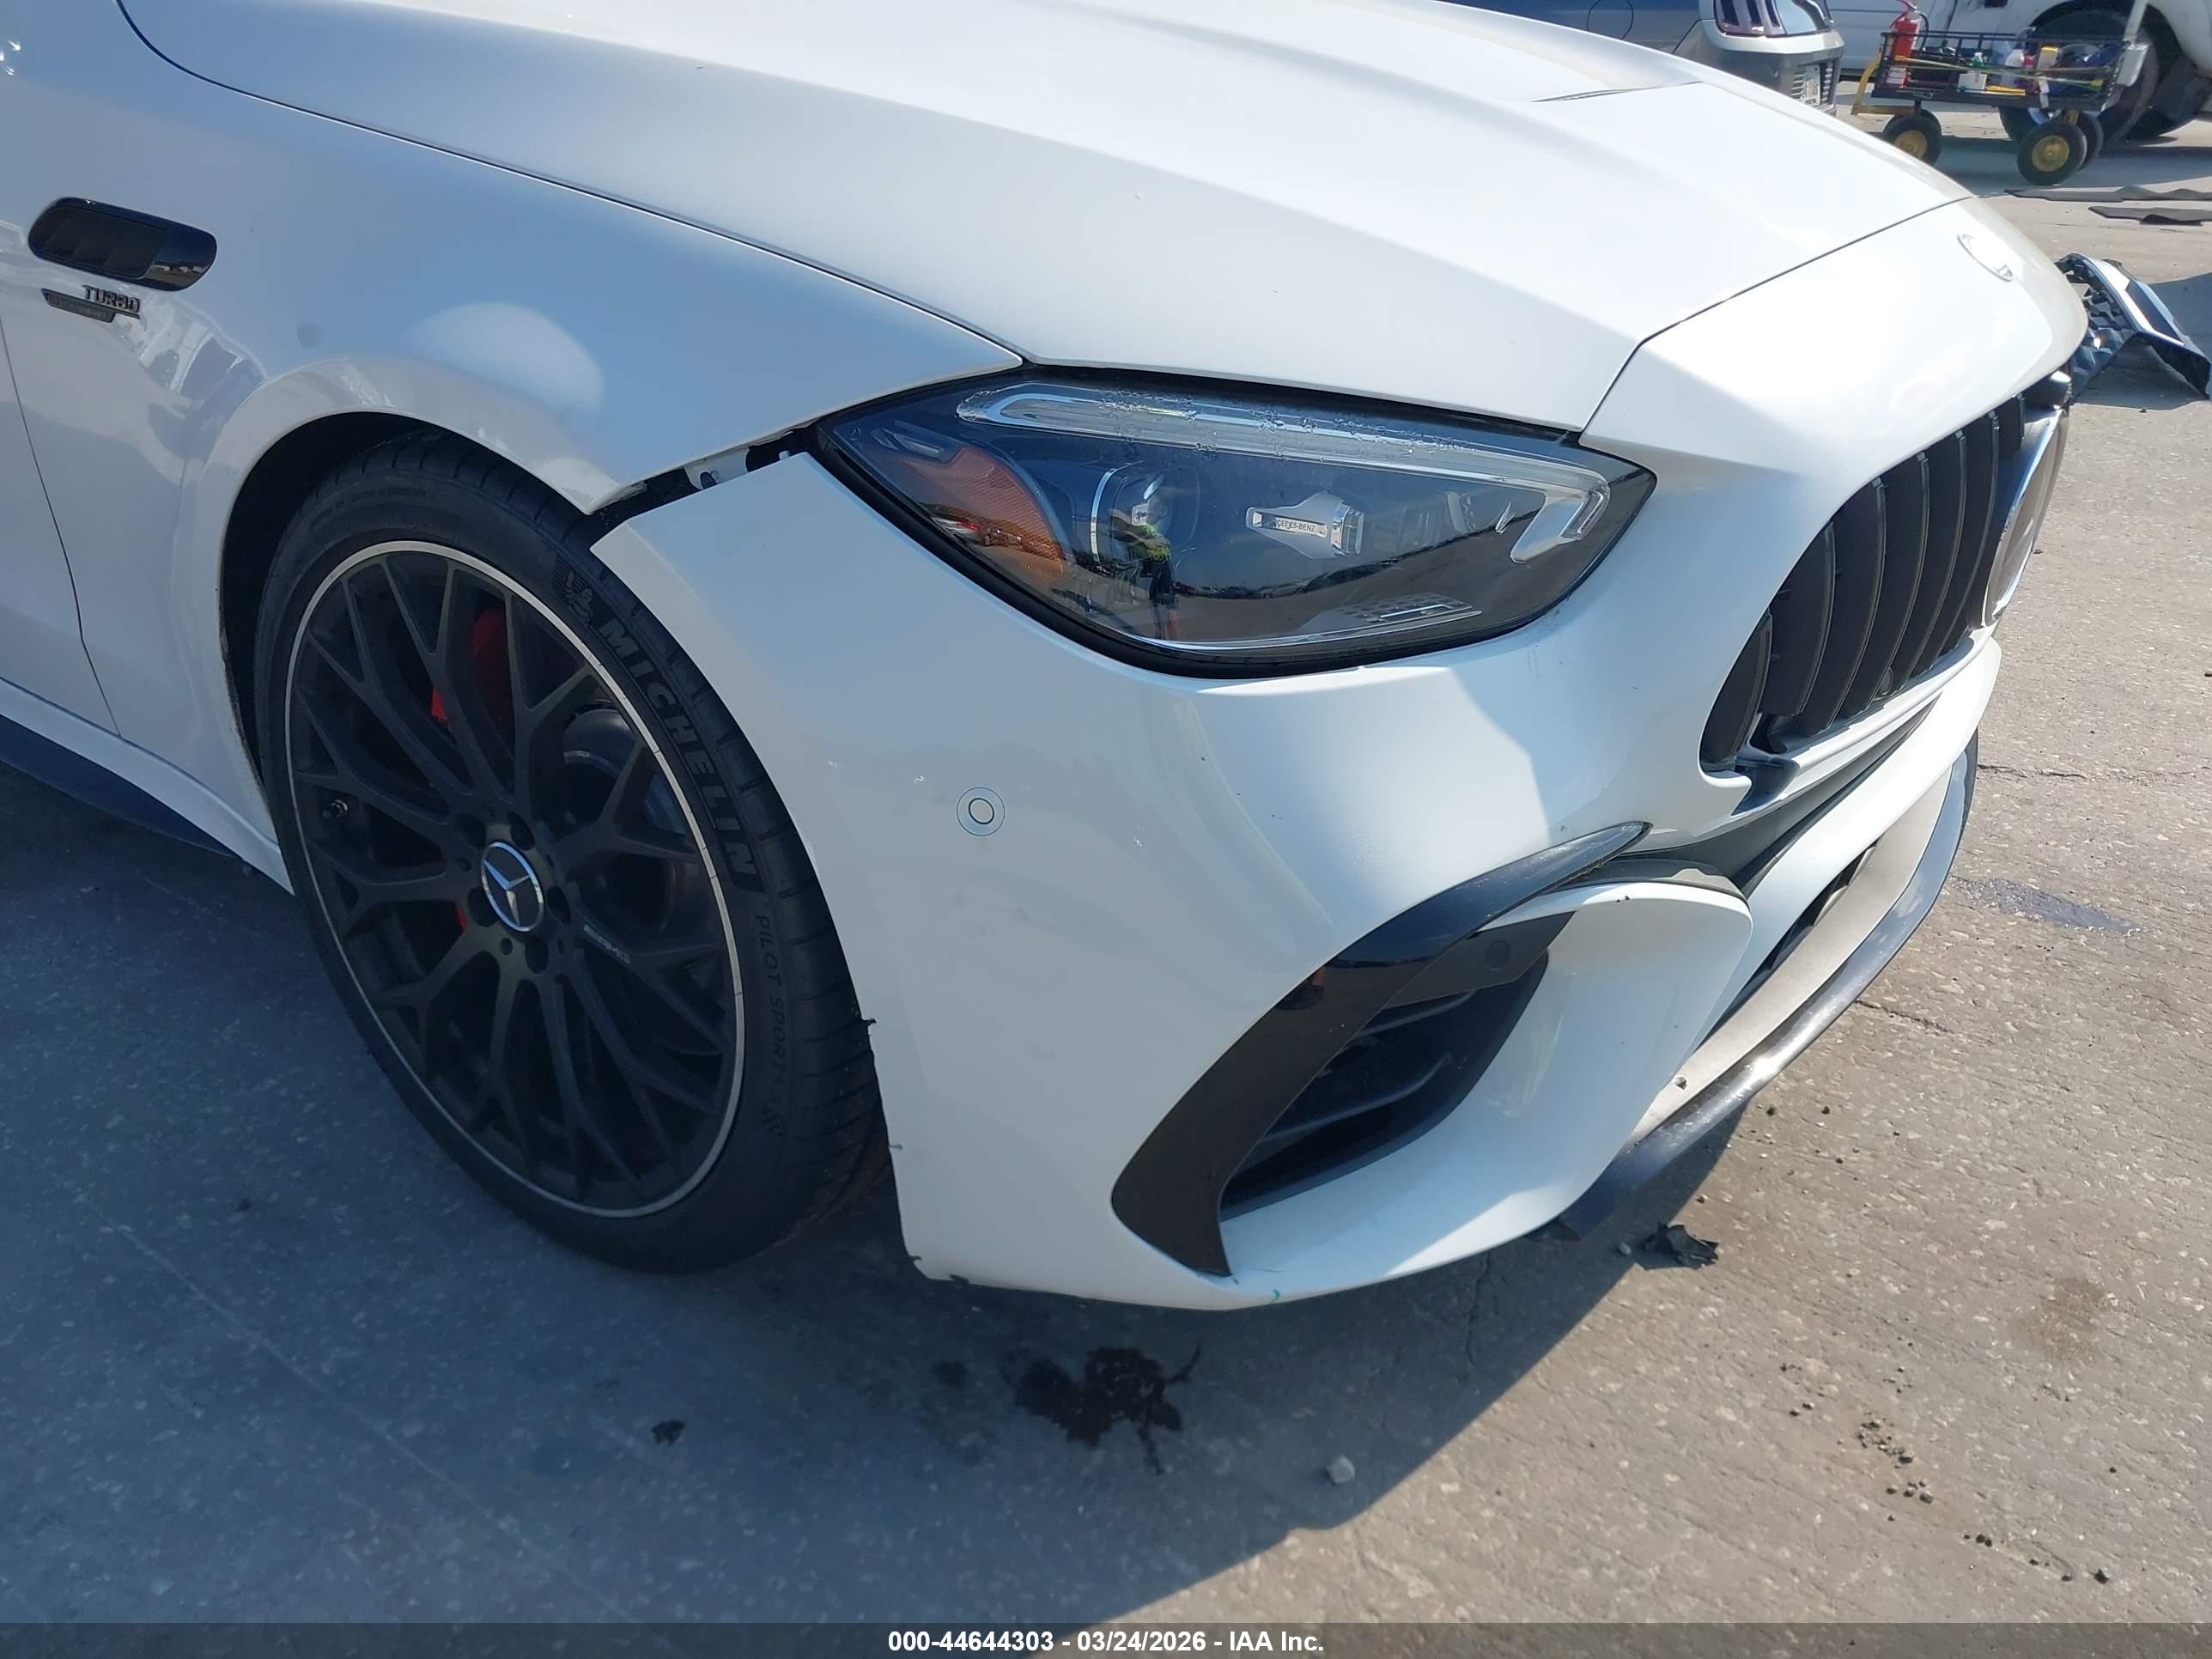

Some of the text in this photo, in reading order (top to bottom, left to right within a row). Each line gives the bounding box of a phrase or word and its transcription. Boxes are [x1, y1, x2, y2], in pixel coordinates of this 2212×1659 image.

[82, 284, 141, 313] TURBO
[599, 616, 757, 876] MICHELIN
[756, 914, 782, 988] PILOT
